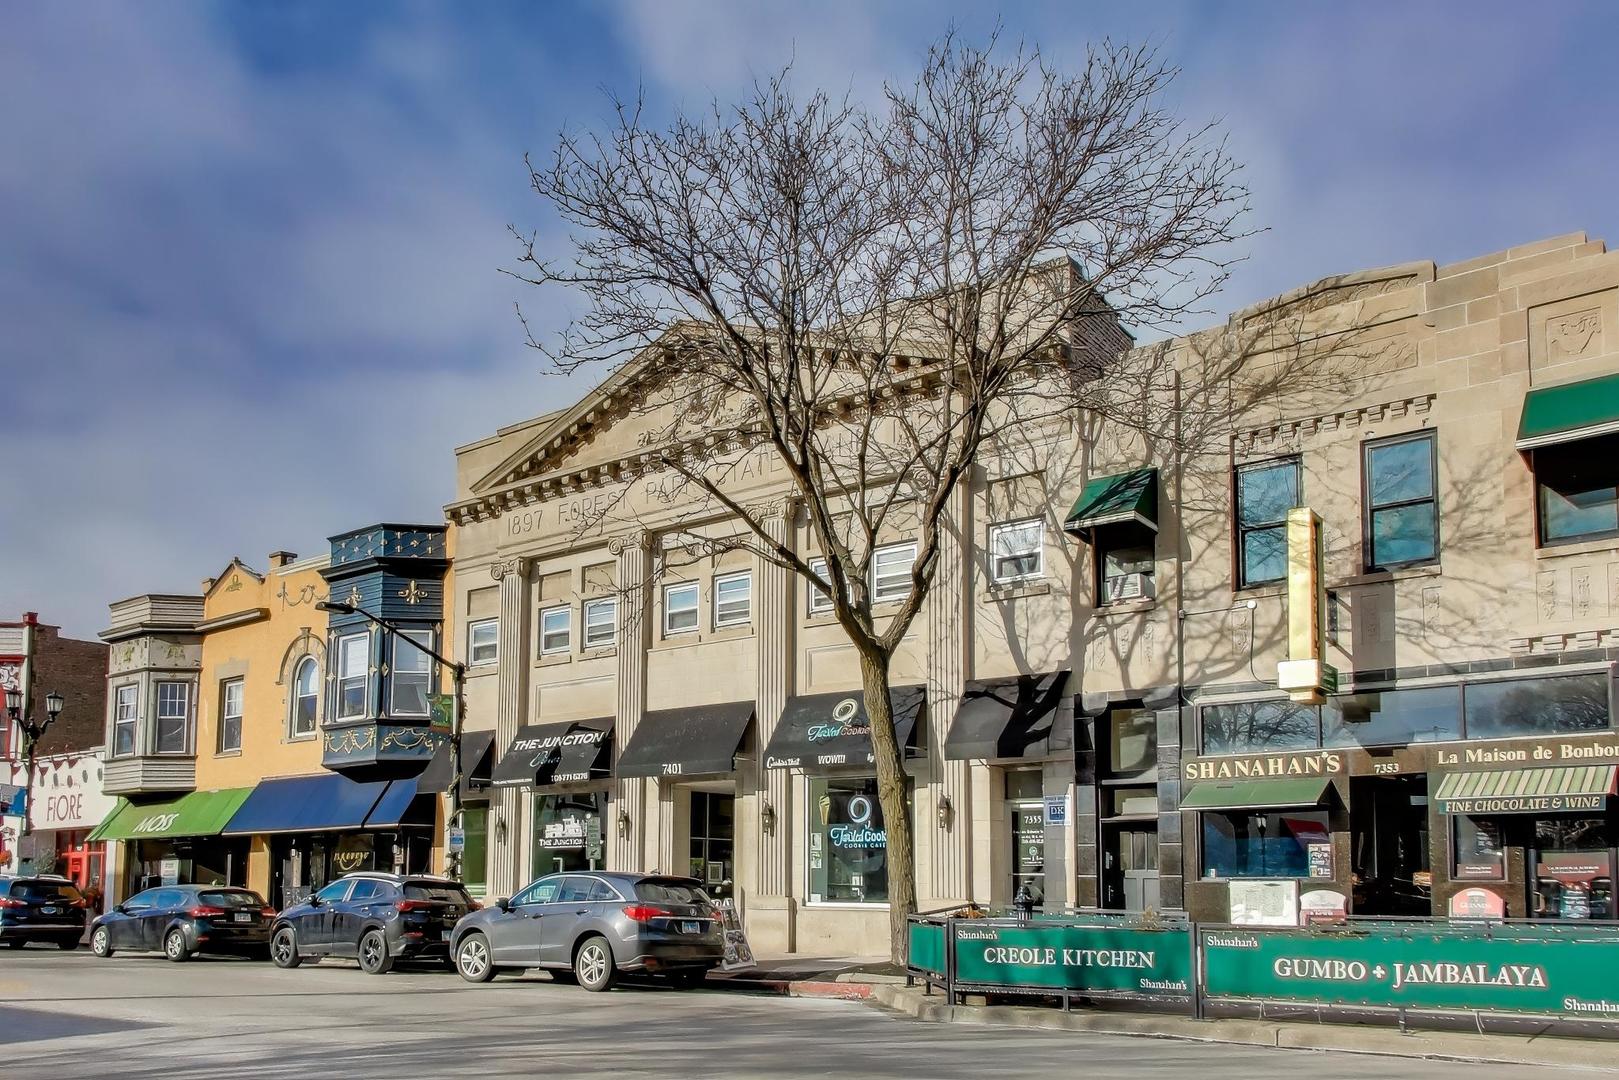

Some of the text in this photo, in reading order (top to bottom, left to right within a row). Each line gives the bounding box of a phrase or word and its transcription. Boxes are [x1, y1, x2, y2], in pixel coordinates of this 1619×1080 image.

[507, 510, 543, 536] 1897
[558, 489, 628, 524] FOREST
[514, 732, 604, 751] THE JUNCTION
[1437, 751, 1458, 765] La
[1465, 748, 1526, 763] Maison
[1533, 746, 1553, 760] de
[662, 763, 682, 775] 7401
[1186, 752, 1341, 780] SHANAHAN'S
[1373, 763, 1400, 774] 7353
[47, 793, 83, 822] FIORE
[1446, 796, 1600, 813] FINE CHOCOLATE & WINE
[132, 813, 180, 833] MOSS
[957, 929, 998, 941] Shanahan's
[1207, 935, 1259, 948] Shanahan's
[983, 947, 1155, 969] CREOLE KITCHEN
[1273, 957, 1547, 989] GUMBO JAMBALAYA
[1139, 978, 1187, 991] Shanahan's
